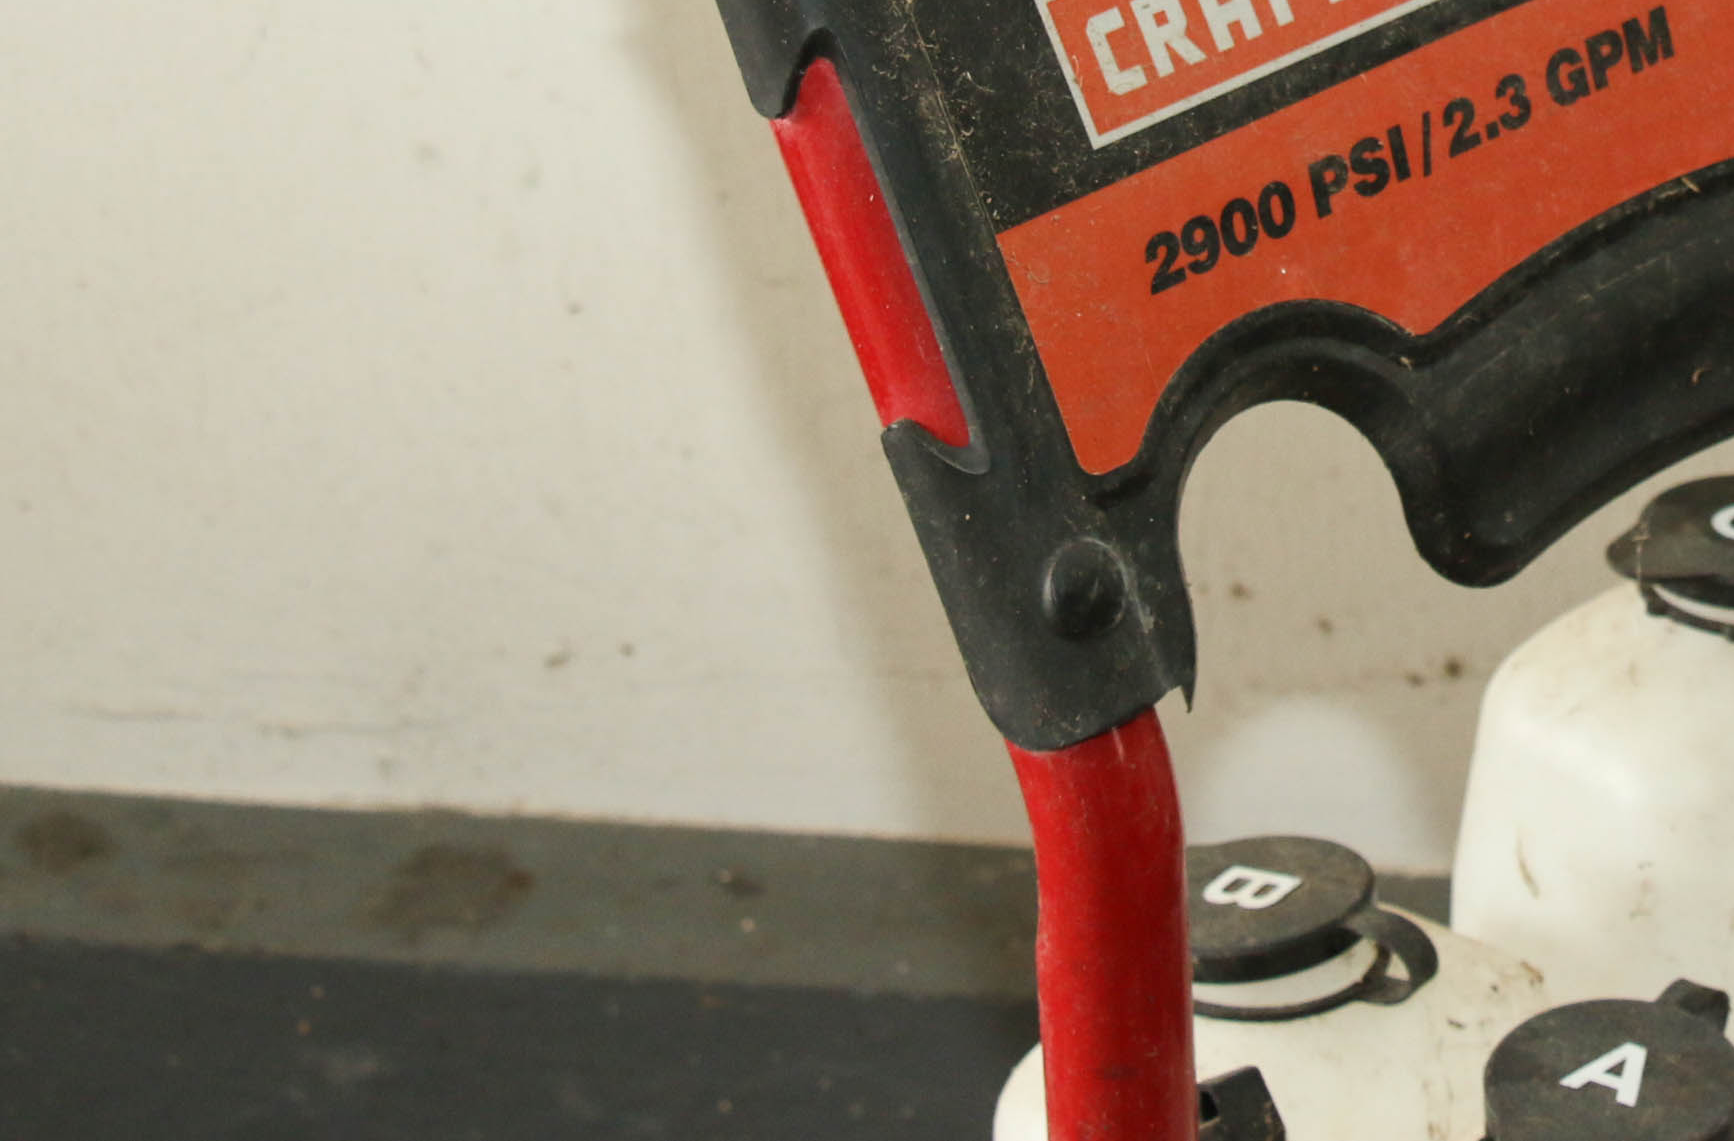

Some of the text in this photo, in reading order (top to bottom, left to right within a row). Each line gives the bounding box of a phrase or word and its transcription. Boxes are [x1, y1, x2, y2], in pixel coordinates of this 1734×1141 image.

[1144, 180, 1297, 296] 2900
[1545, 6, 1674, 108] GPM
[1201, 864, 1302, 911] B
[1559, 1041, 1648, 1108] A
